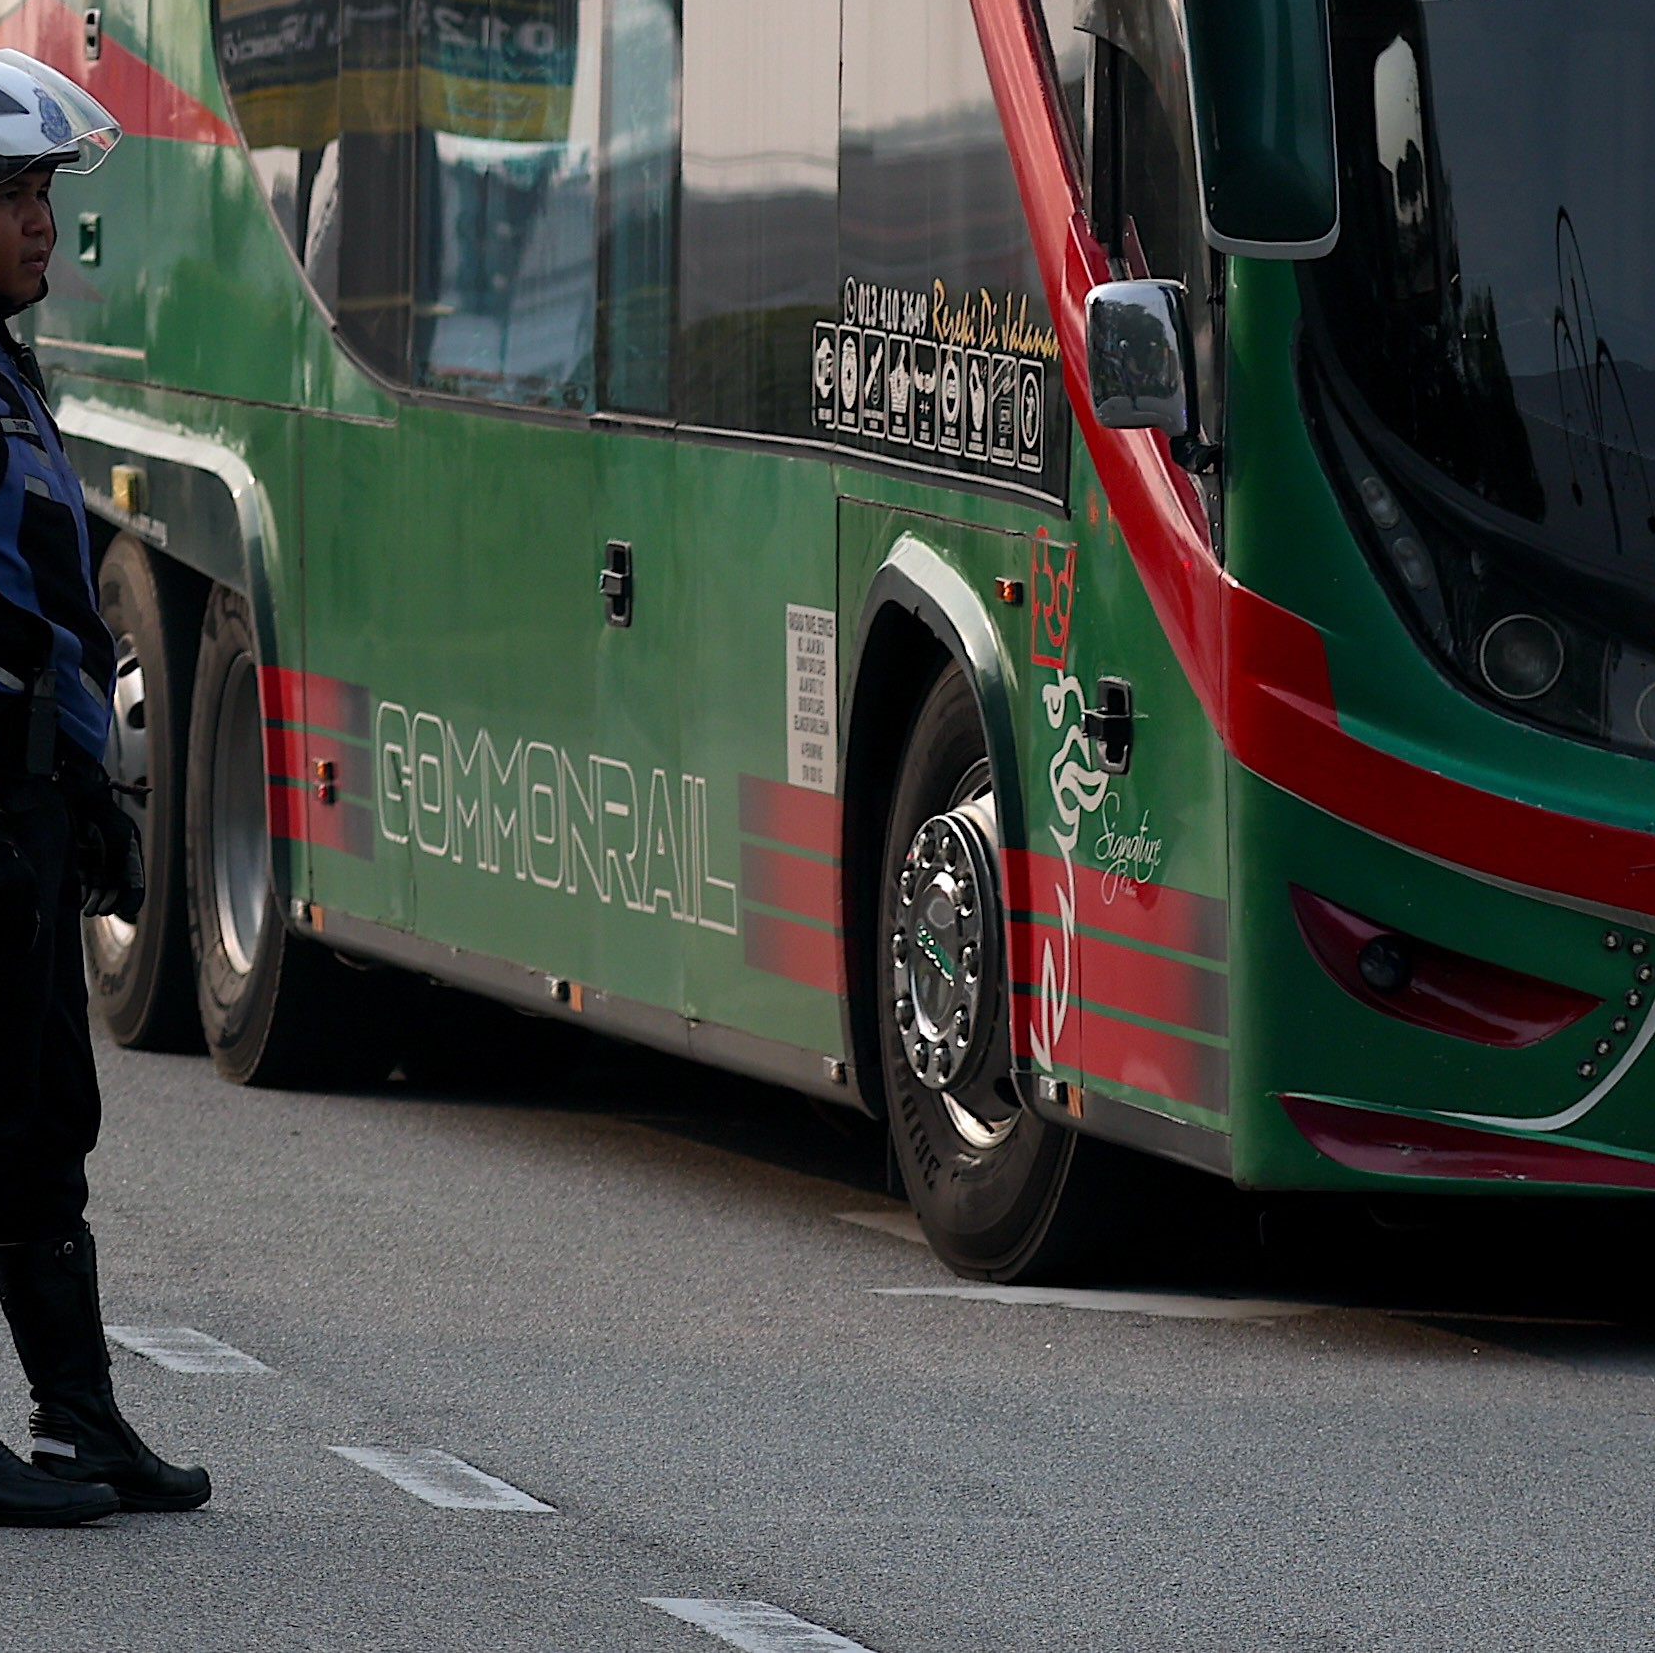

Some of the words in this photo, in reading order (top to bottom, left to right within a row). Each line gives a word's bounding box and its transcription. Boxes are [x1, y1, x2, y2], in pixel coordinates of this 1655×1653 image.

[858, 282, 878, 328] 013
[879, 286, 900, 333] 410
[901, 289, 929, 337] 3649
[978, 287, 999, 351] Di
